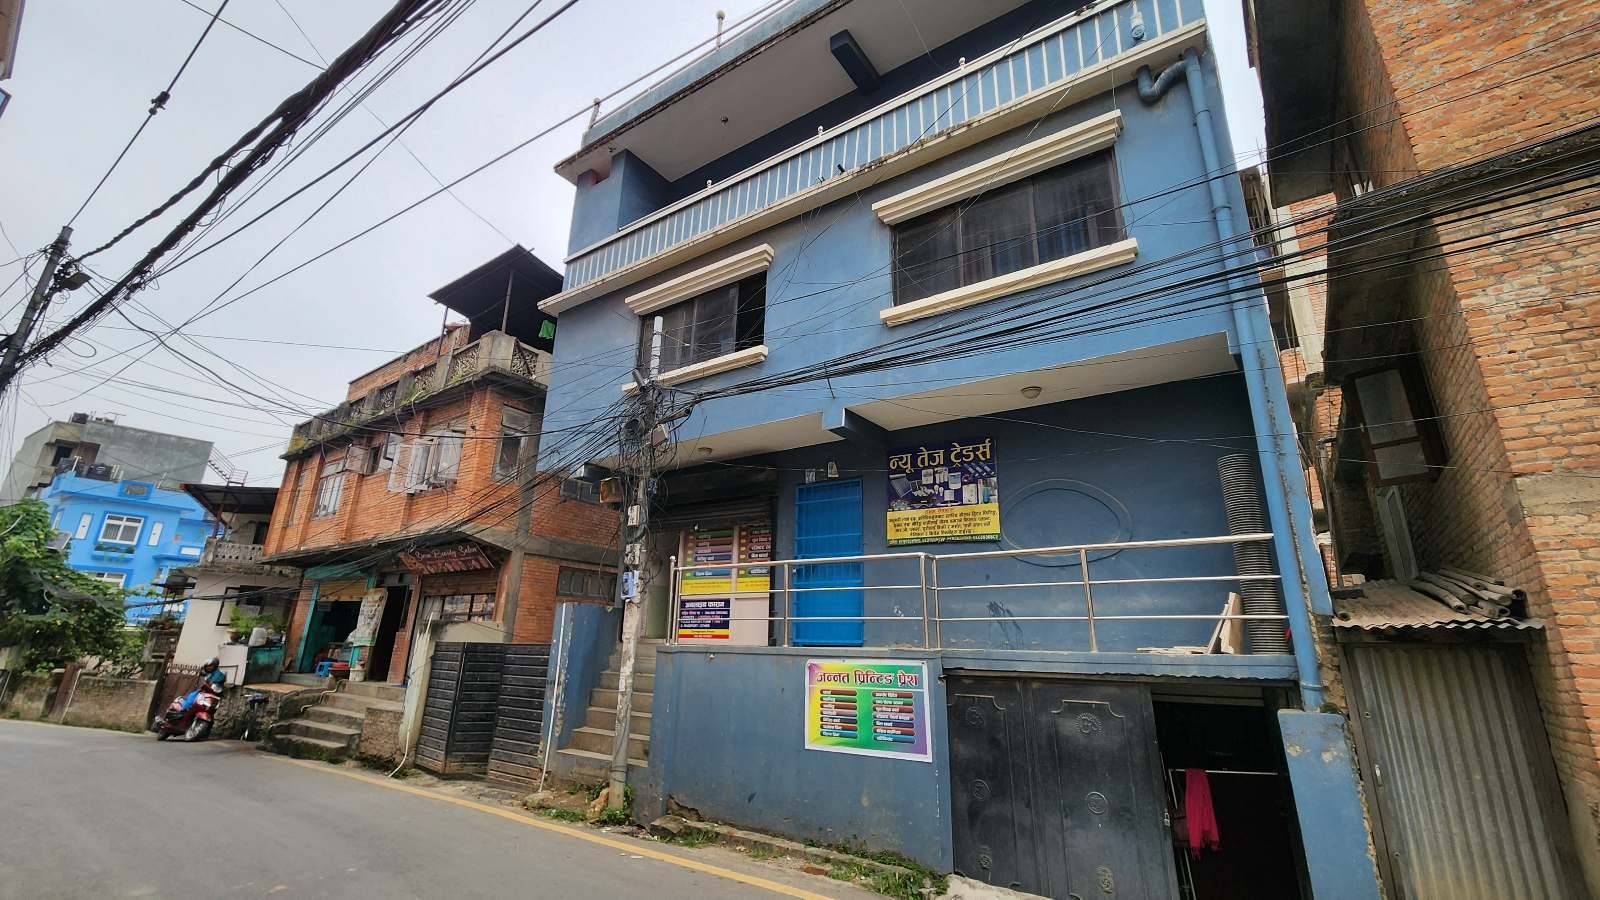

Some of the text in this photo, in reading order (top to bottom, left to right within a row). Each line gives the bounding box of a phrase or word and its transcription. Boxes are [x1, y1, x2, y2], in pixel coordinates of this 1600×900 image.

[889, 438, 992, 474] न्यू तेज ट्रेडर्स
[817, 672, 849, 684] जन्नत
